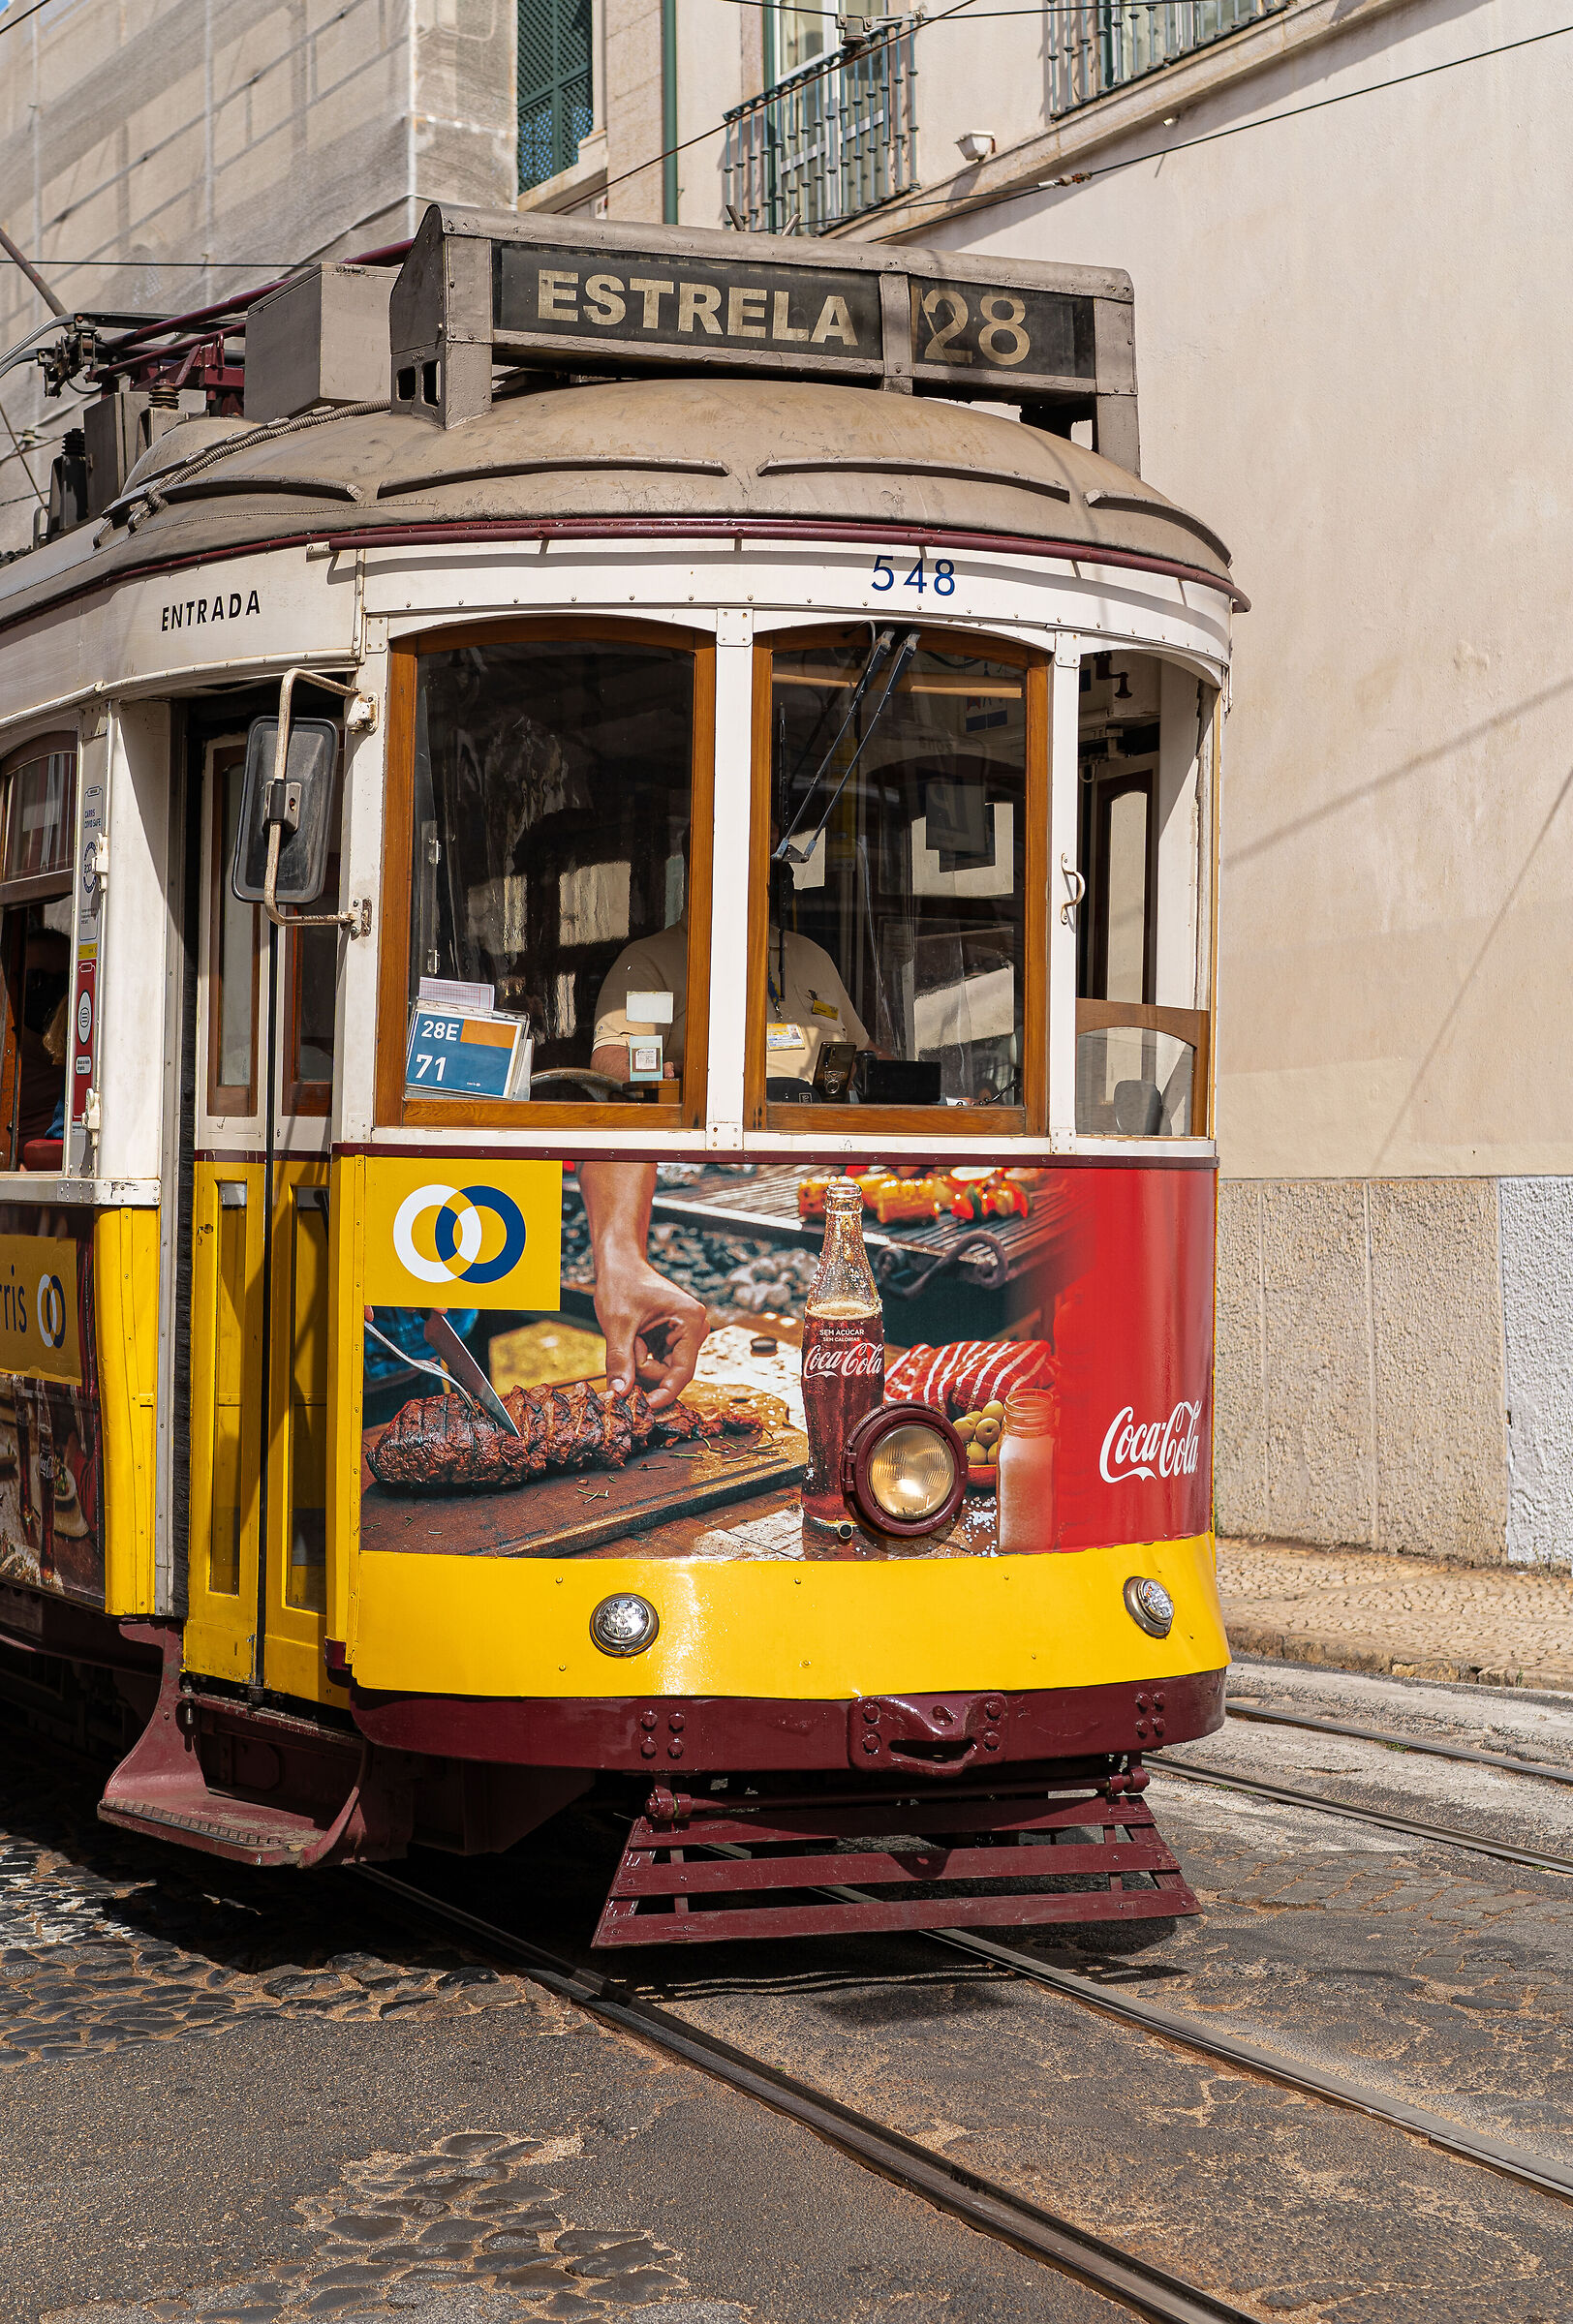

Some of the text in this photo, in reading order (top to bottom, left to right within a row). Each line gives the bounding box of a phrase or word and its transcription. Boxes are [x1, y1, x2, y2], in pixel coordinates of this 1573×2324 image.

[538, 269, 1031, 366] ESTRELA 28
[871, 555, 956, 596] 548
[161, 589, 262, 632] ENTRADA
[420, 1020, 460, 1041] 28E
[415, 1054, 447, 1082] 71
[803, 1342, 884, 1379] Coca-Cola
[1098, 1399, 1203, 1483] Coca-Cola
